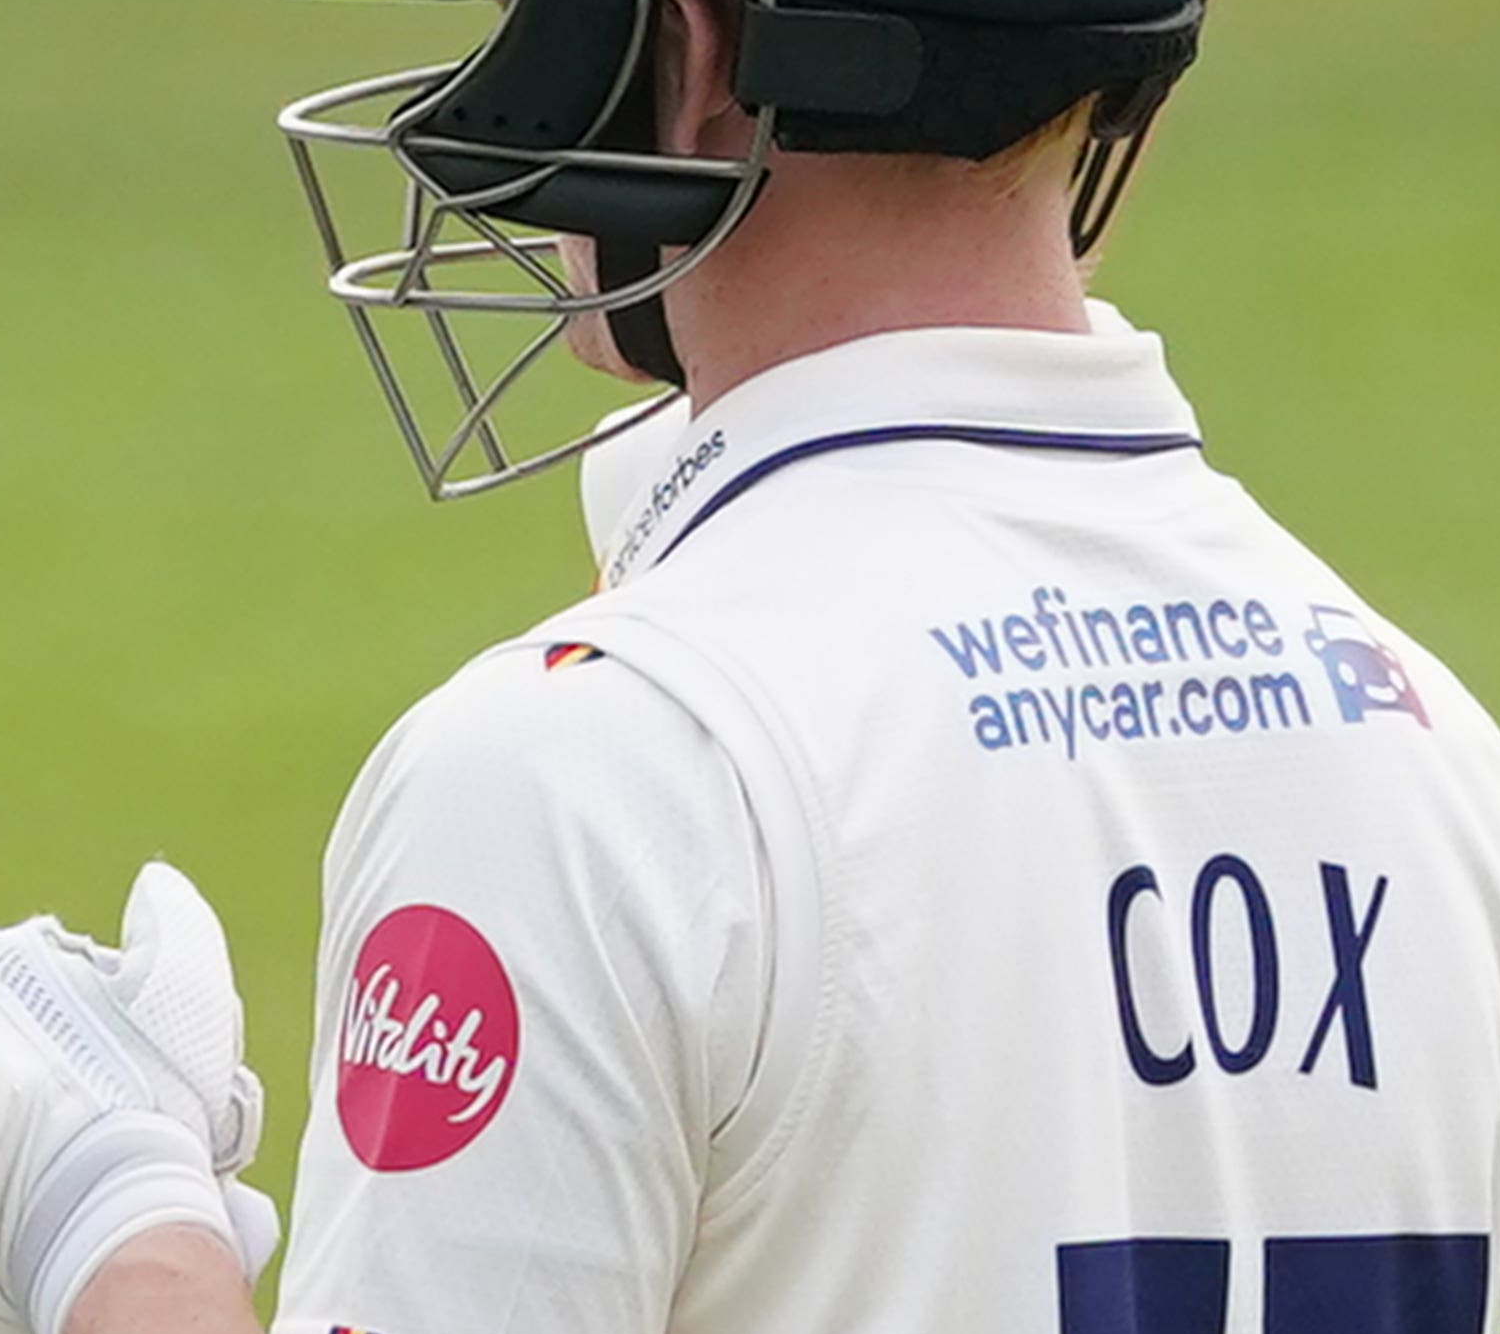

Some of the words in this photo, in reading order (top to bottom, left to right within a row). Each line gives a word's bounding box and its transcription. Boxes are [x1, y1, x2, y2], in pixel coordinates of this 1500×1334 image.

[928, 586, 1285, 680] wefinance
[968, 671, 1313, 761] anycar.com
[1105, 852, 1390, 1092] COX
[343, 964, 507, 1125] Vitality
